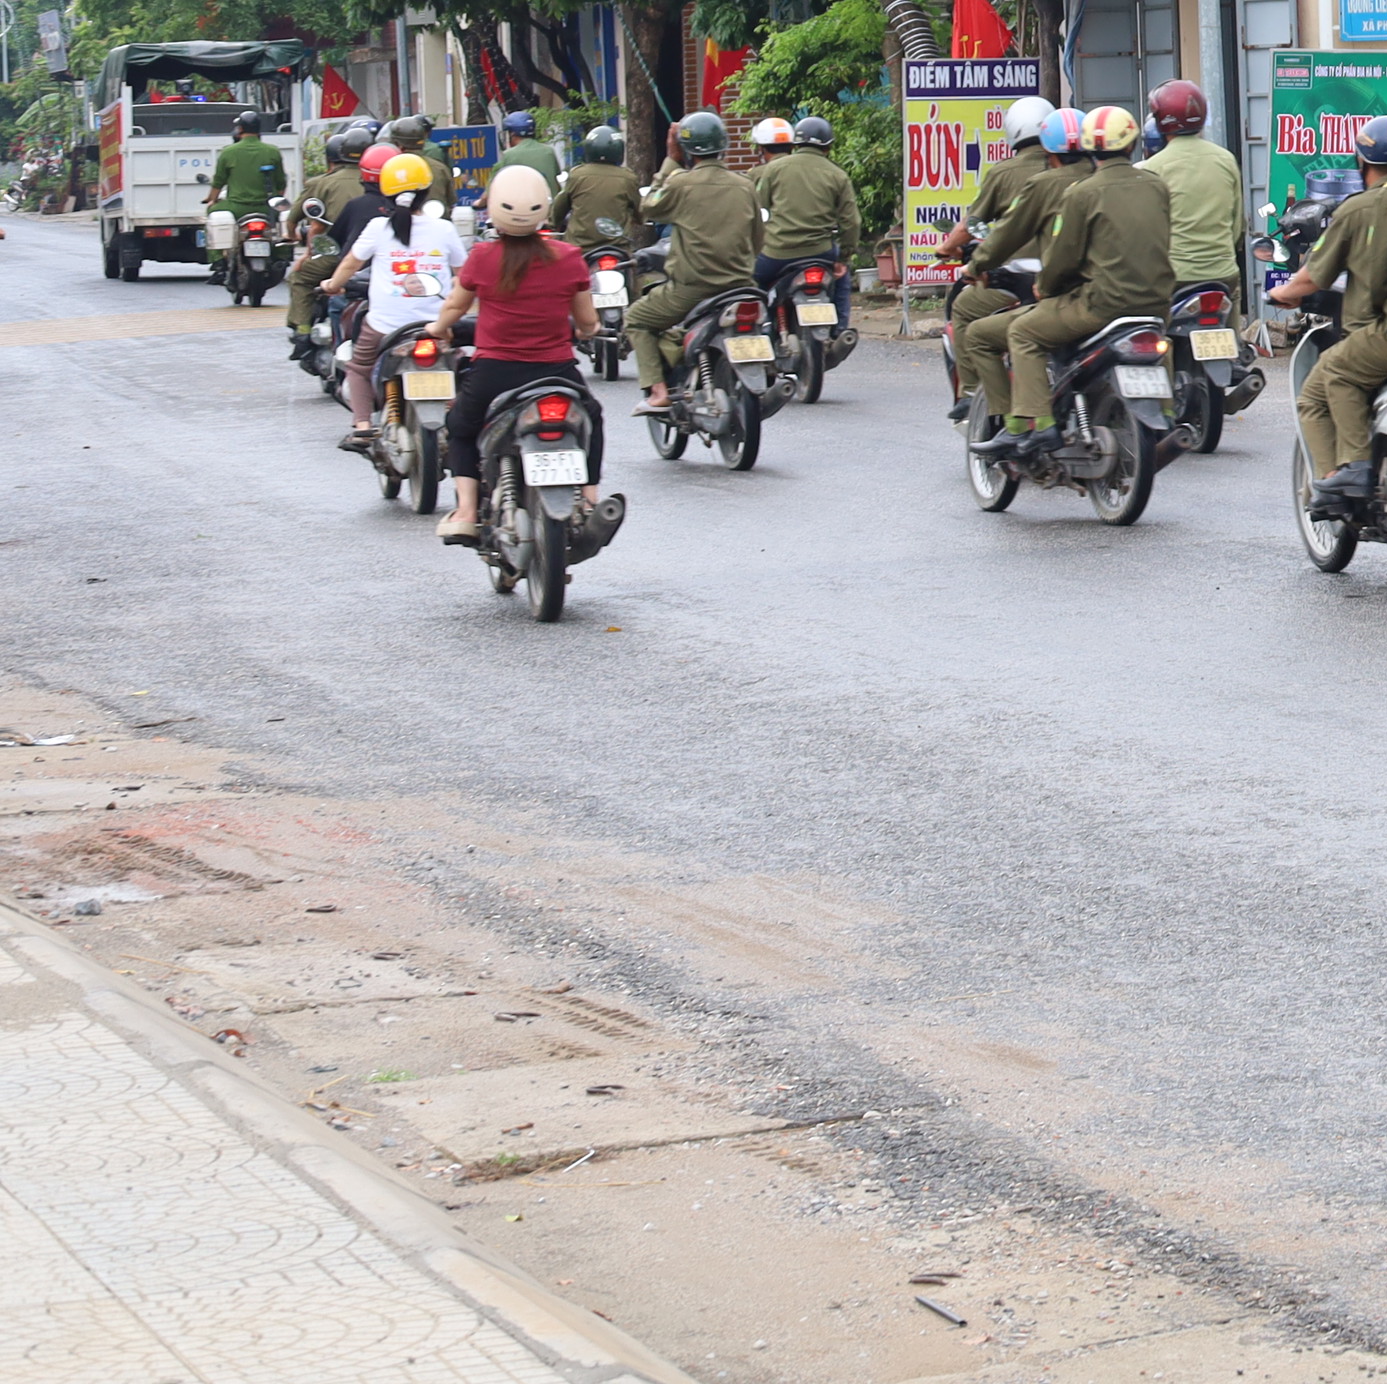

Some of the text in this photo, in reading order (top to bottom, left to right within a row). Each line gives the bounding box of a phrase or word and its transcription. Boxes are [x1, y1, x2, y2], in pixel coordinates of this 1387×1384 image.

[954, 61, 988, 88] TÂM
[993, 60, 1037, 88] SÁNG
[907, 103, 962, 189] BÚN
[1276, 114, 1316, 154] Bia
